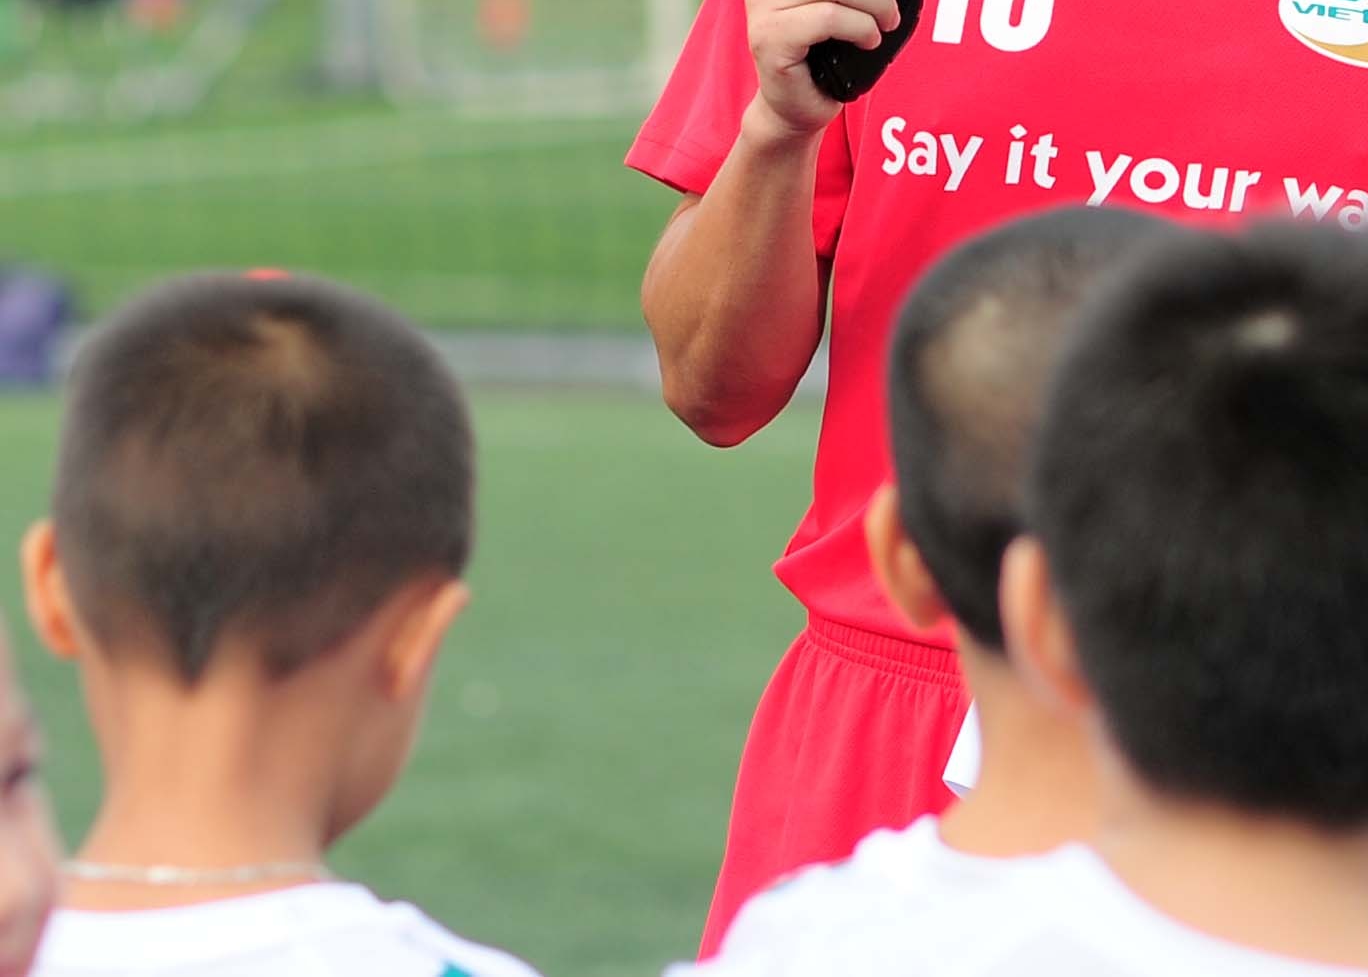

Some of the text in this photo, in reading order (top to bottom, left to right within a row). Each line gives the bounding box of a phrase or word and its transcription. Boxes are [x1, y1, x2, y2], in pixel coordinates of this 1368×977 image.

[880, 116, 984, 192] Say
[1004, 124, 1060, 190] it
[1084, 150, 1261, 213] your
